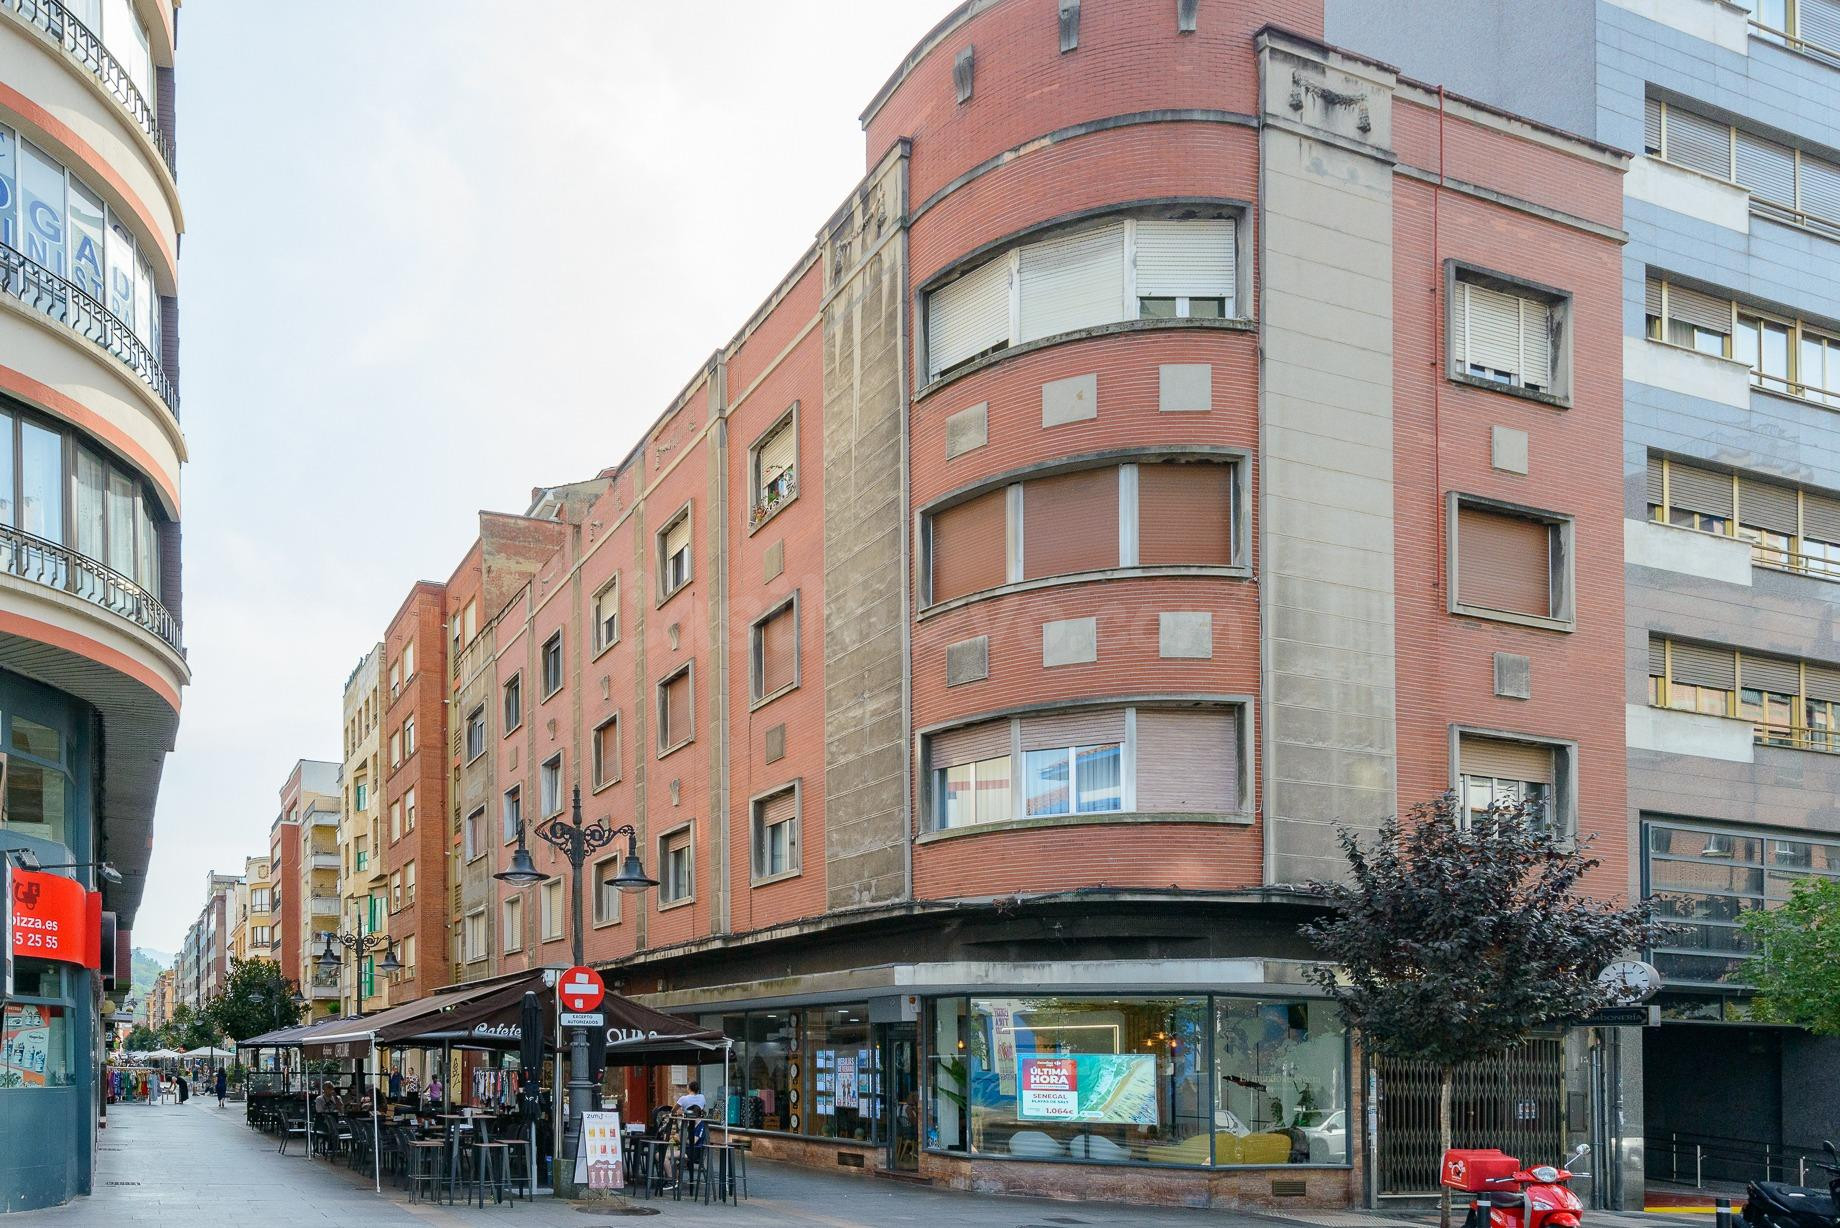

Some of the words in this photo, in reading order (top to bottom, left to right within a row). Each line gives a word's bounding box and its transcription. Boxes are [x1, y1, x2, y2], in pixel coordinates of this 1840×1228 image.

[12, 932, 24, 945] 5
[27, 933, 42, 947] 25
[45, 935, 58, 949] 55
[1030, 1066, 1069, 1076] ÚLTIMA
[1030, 1075, 1069, 1085] HORA
